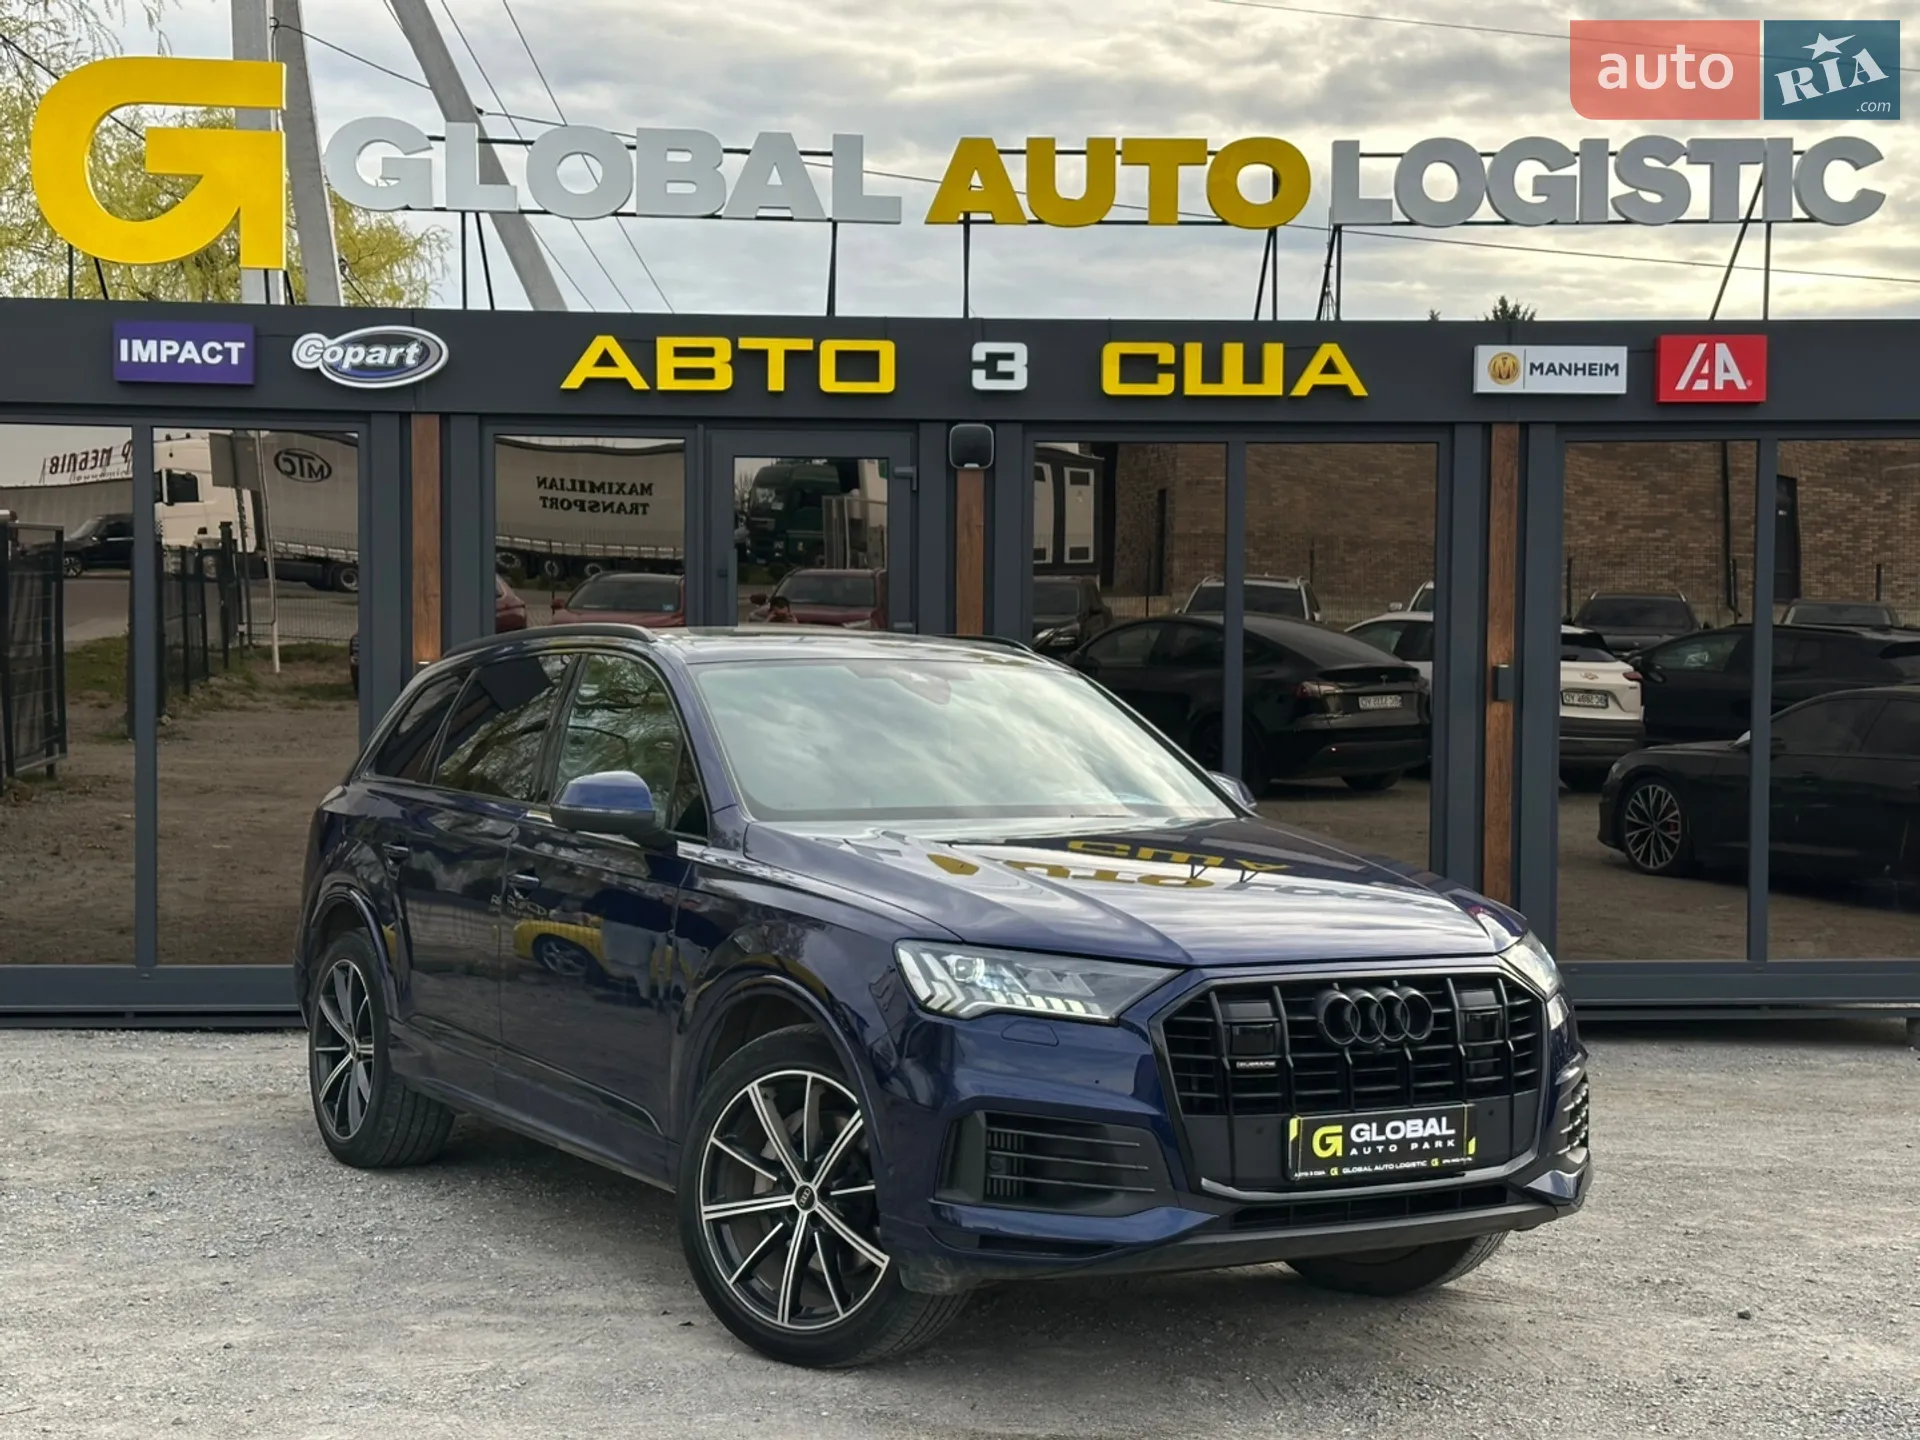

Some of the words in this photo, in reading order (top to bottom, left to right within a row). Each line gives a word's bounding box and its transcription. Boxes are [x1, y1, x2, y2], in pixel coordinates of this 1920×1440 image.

[324, 116, 902, 224] GLOBAL
[926, 137, 1311, 229] AUTO
[1331, 134, 1887, 227] LOGISTIC
[119, 338, 245, 365] IMPACT
[298, 338, 423, 370] Copart
[560, 335, 896, 394] АВТО
[1102, 341, 1368, 397] США
[1529, 361, 1619, 377] MANHEIM
[1350, 1116, 1456, 1143] GLOBAL
[1350, 1144, 1398, 1156] AUTO
[1411, 1139, 1455, 1151] PARK
[1374, 1162, 1396, 1172] AUTO
